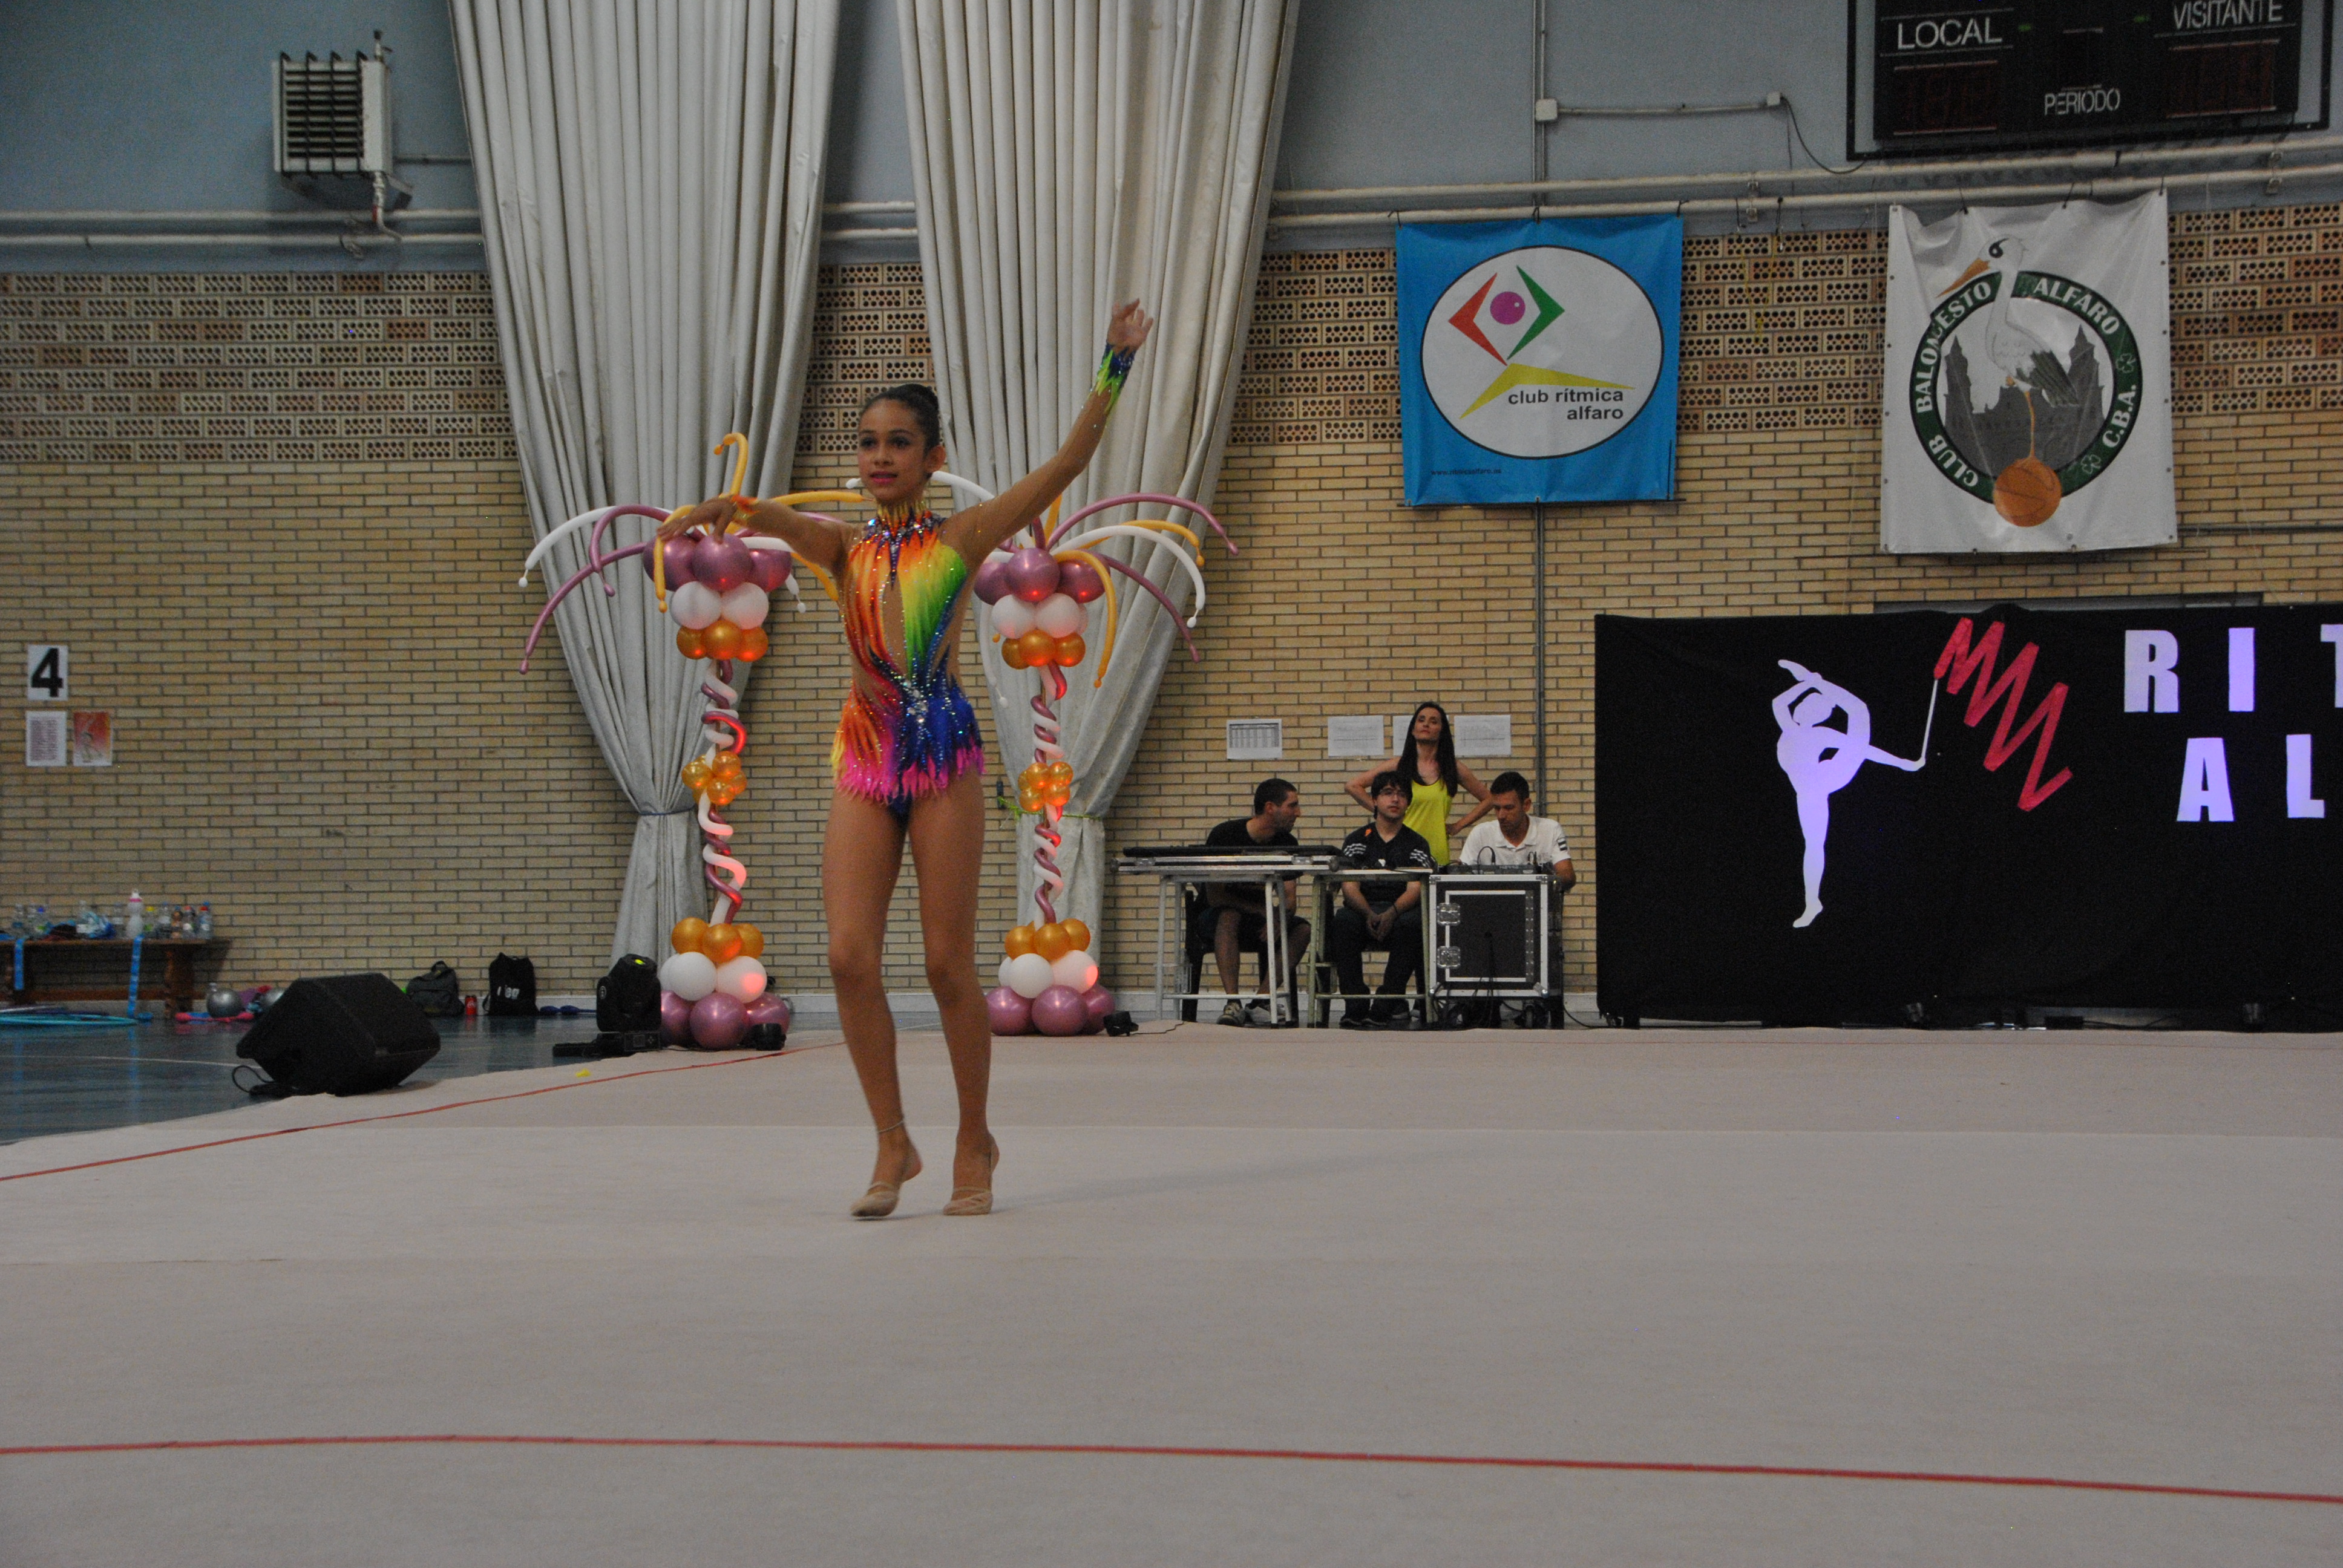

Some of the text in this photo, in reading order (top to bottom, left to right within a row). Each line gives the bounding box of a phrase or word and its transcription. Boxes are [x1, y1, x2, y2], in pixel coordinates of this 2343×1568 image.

[2173, 0, 2283, 29] VISITANTE
[1898, 16, 2003, 50] LOCAL
[2044, 88, 2120, 116] PERIODO
[1508, 388, 1624, 405] club rítmica
[1915, 278, 2120, 487] CLUB BALONCESTO ALFARO
[1567, 405, 1624, 420] alfaro
[2102, 384, 2137, 448] C.B.A.
[31, 648, 64, 697] 4
